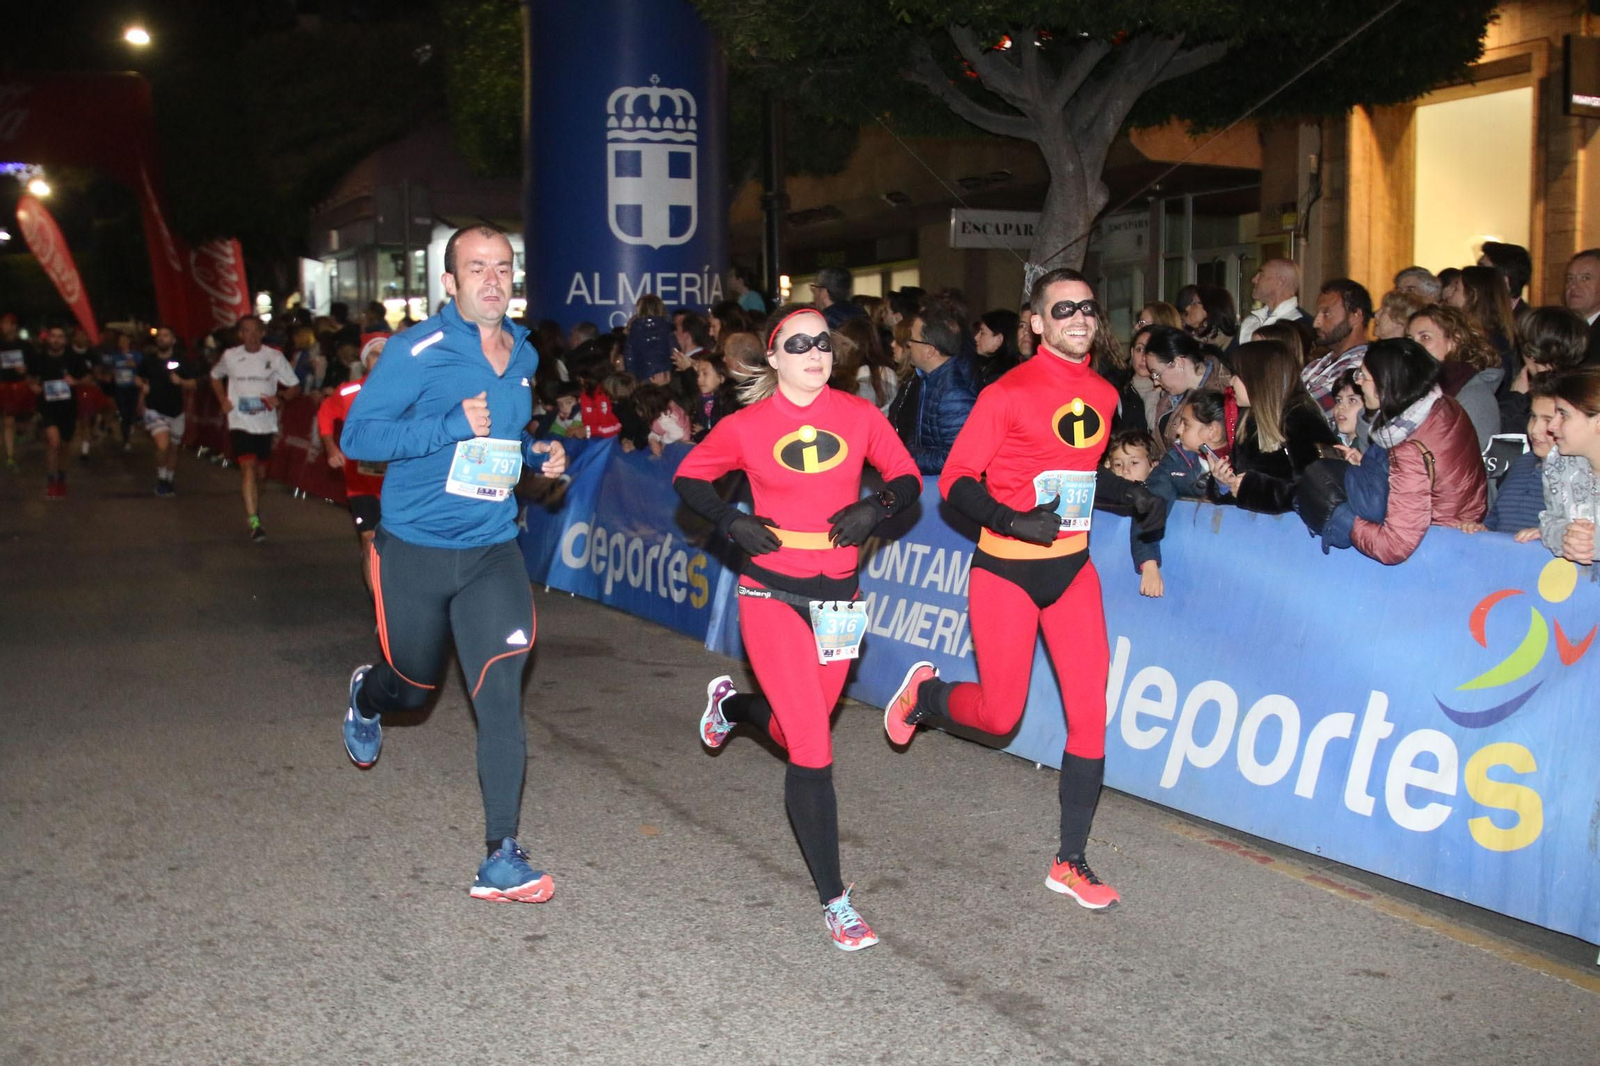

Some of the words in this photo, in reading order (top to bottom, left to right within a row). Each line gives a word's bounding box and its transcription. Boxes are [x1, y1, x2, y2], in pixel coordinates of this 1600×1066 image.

[960, 220, 1035, 237] ESCAPAR
[565, 264, 724, 306] ALMERÍA
[491, 457, 516, 474] 797
[1066, 488, 1089, 504] 315
[561, 511, 709, 610] deportes
[826, 618, 858, 634] 316
